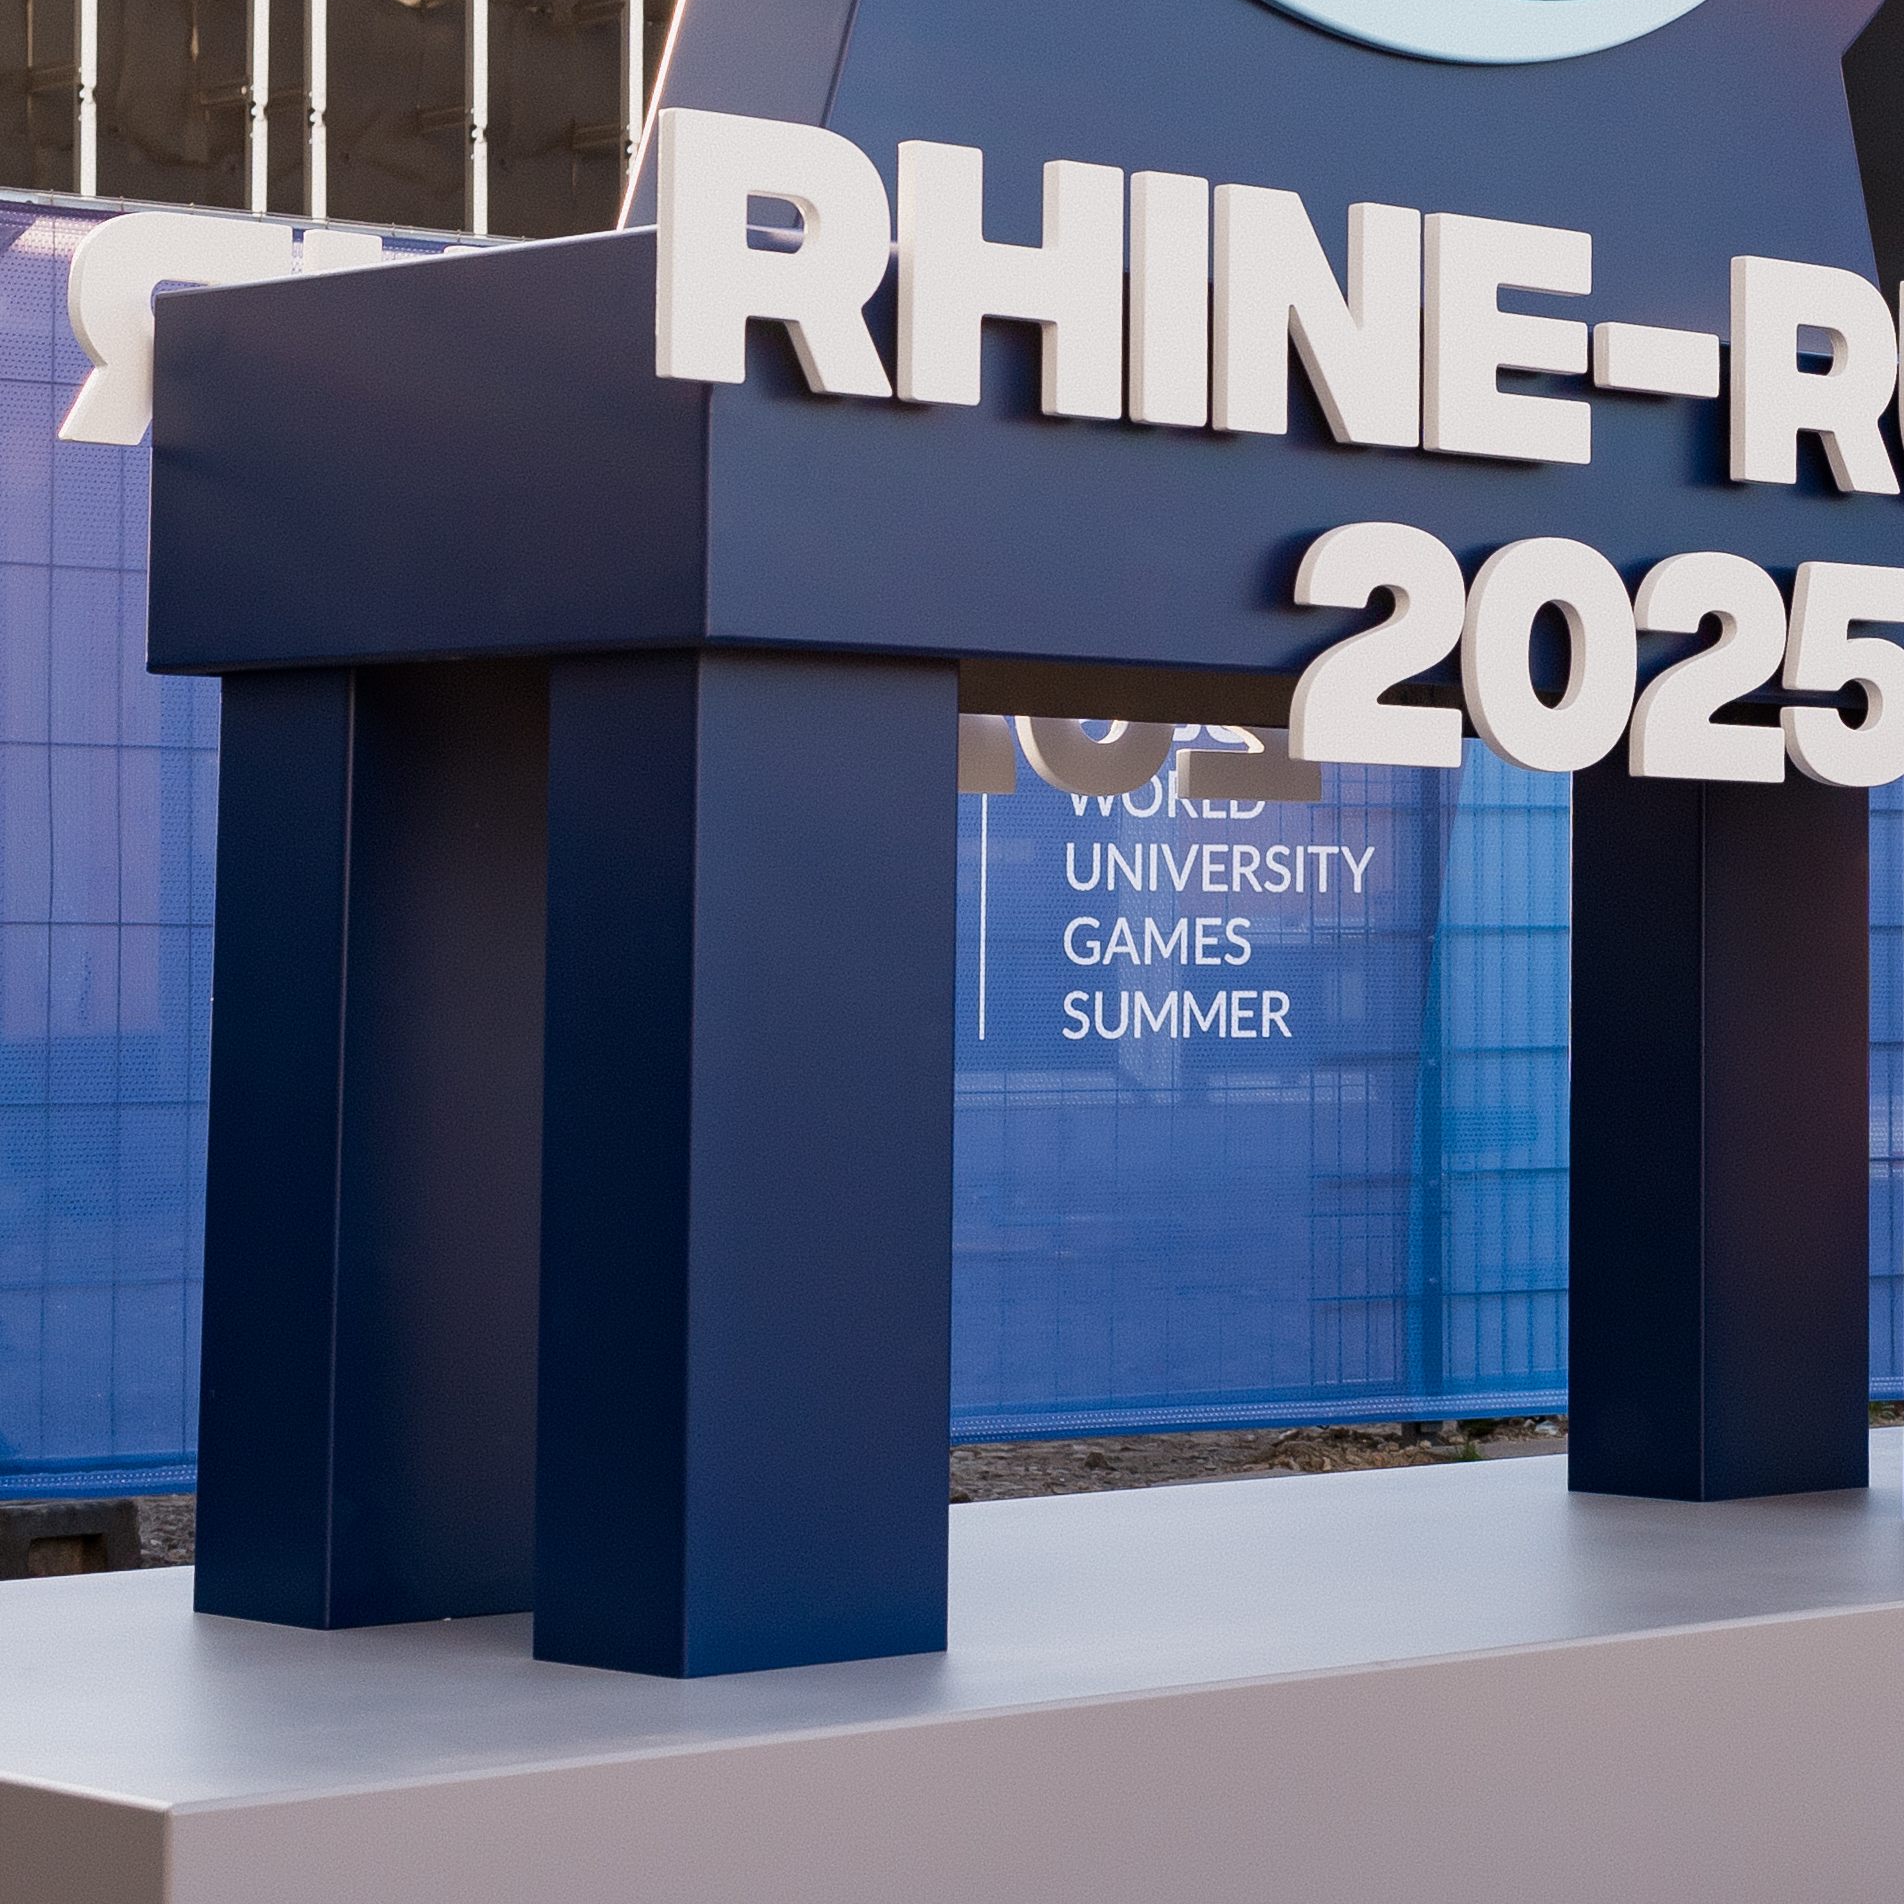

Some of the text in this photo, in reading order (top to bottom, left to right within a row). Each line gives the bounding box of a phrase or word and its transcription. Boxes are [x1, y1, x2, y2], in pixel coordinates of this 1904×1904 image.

[1066, 842, 1375, 894] UNIVERSITY
[1062, 916, 1252, 966] GAMES
[1062, 990, 1292, 1040] SUMMER
